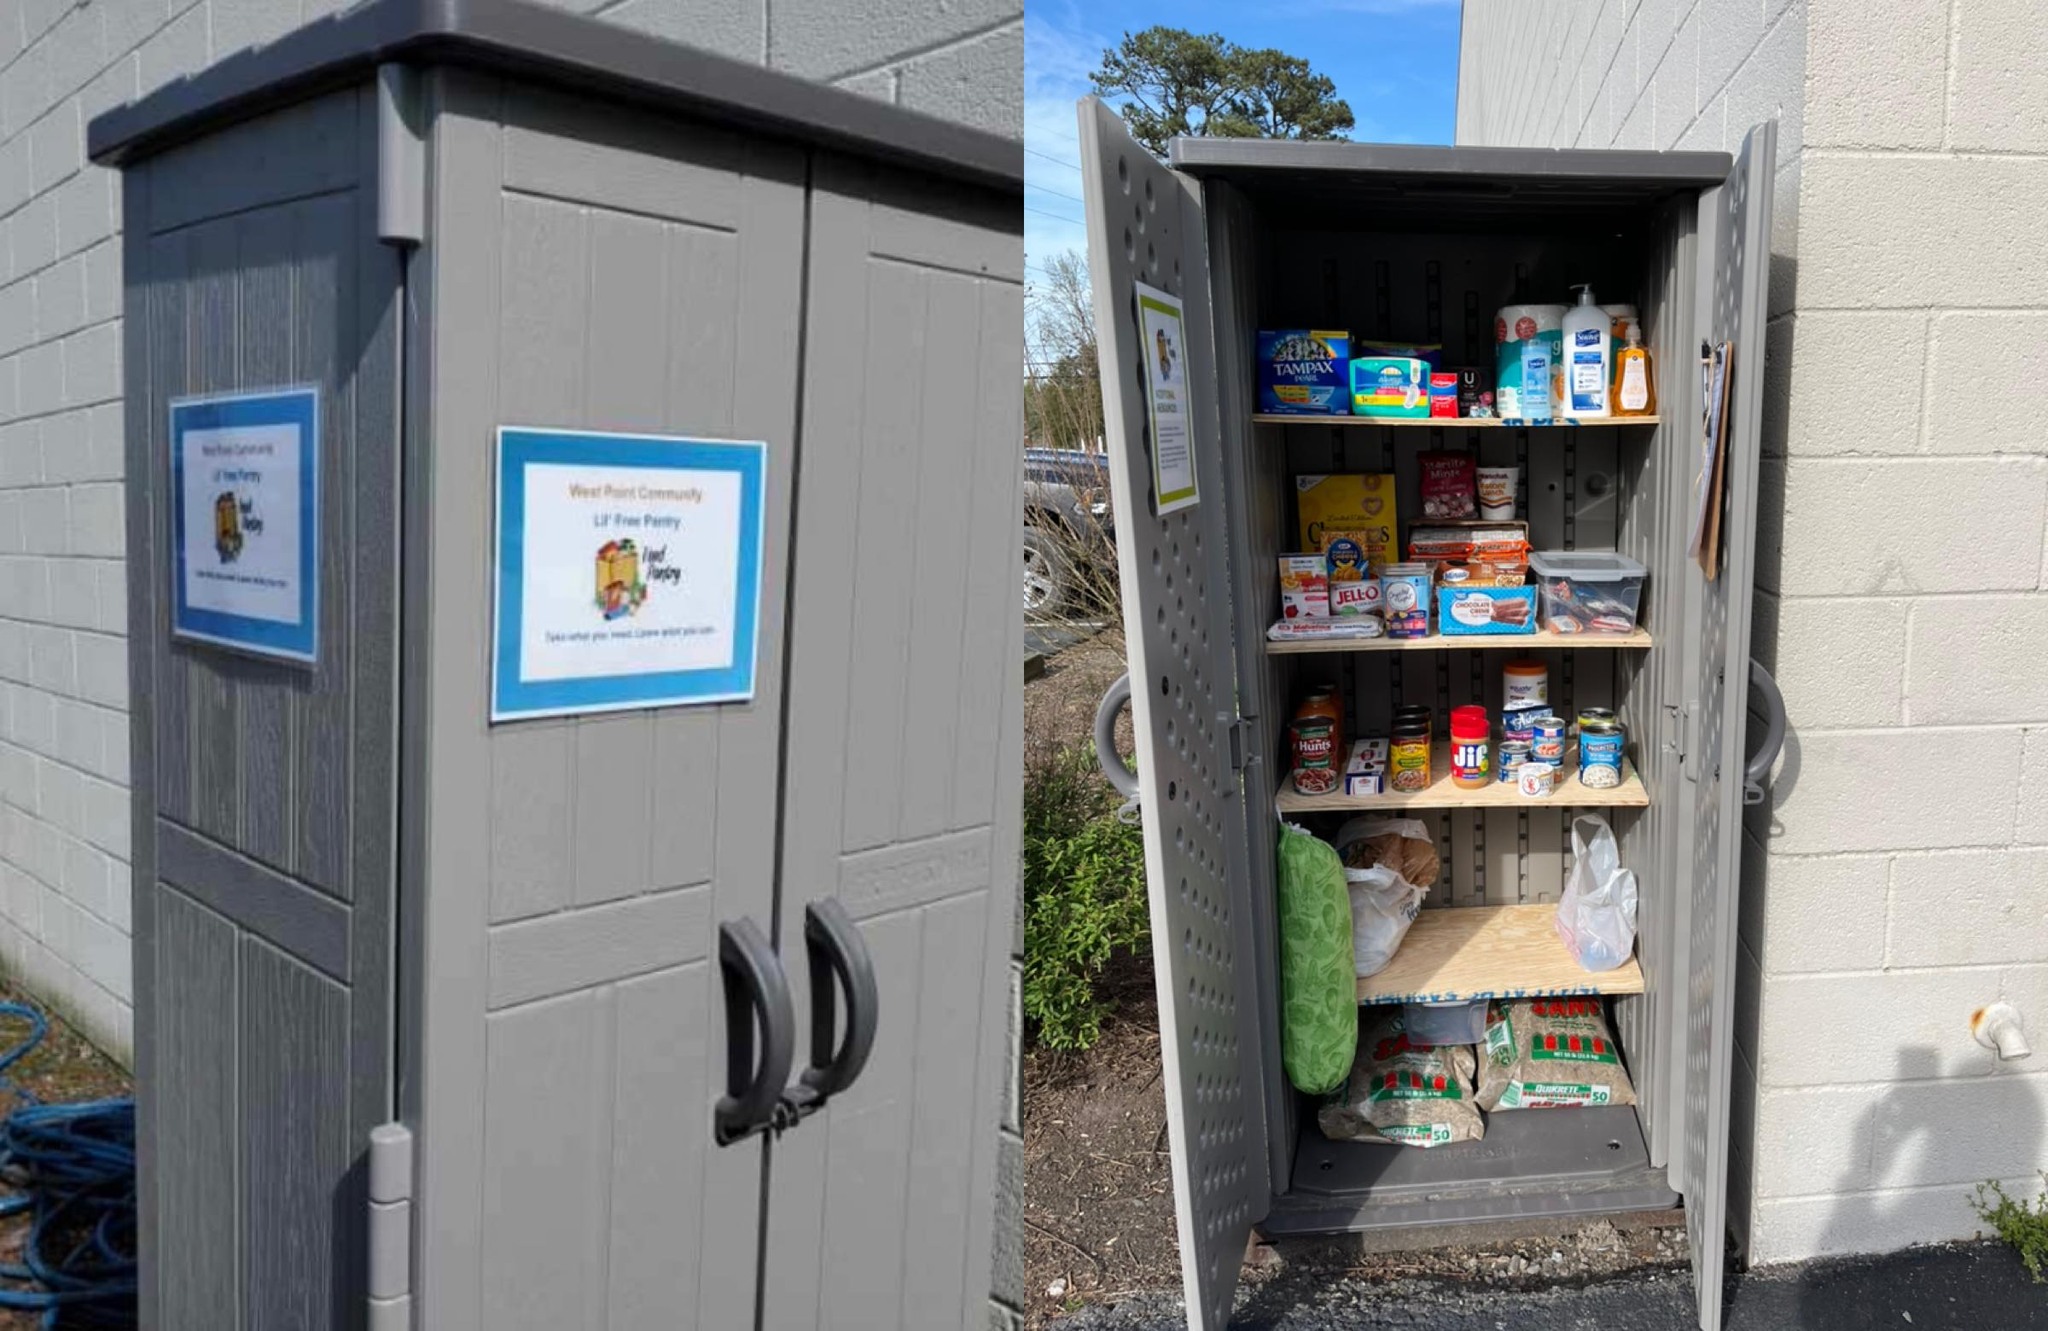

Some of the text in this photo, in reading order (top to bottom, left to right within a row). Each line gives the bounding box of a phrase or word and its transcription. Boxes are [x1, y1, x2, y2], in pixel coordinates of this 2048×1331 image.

[1577, 331, 1600, 342] Suave
[1273, 361, 1334, 376] TAMPAX
[1464, 372, 1475, 384] U
[1430, 470, 1460, 479] Mints
[569, 483, 703, 504] West Point Community
[615, 514, 641, 527] Free
[644, 515, 681, 529] Pantry
[1454, 744, 1488, 767] Jif
[1535, 1084, 1579, 1093] QUIKRETE
[1593, 1092, 1608, 1101] 50
[1433, 1130, 1450, 1141] 50
